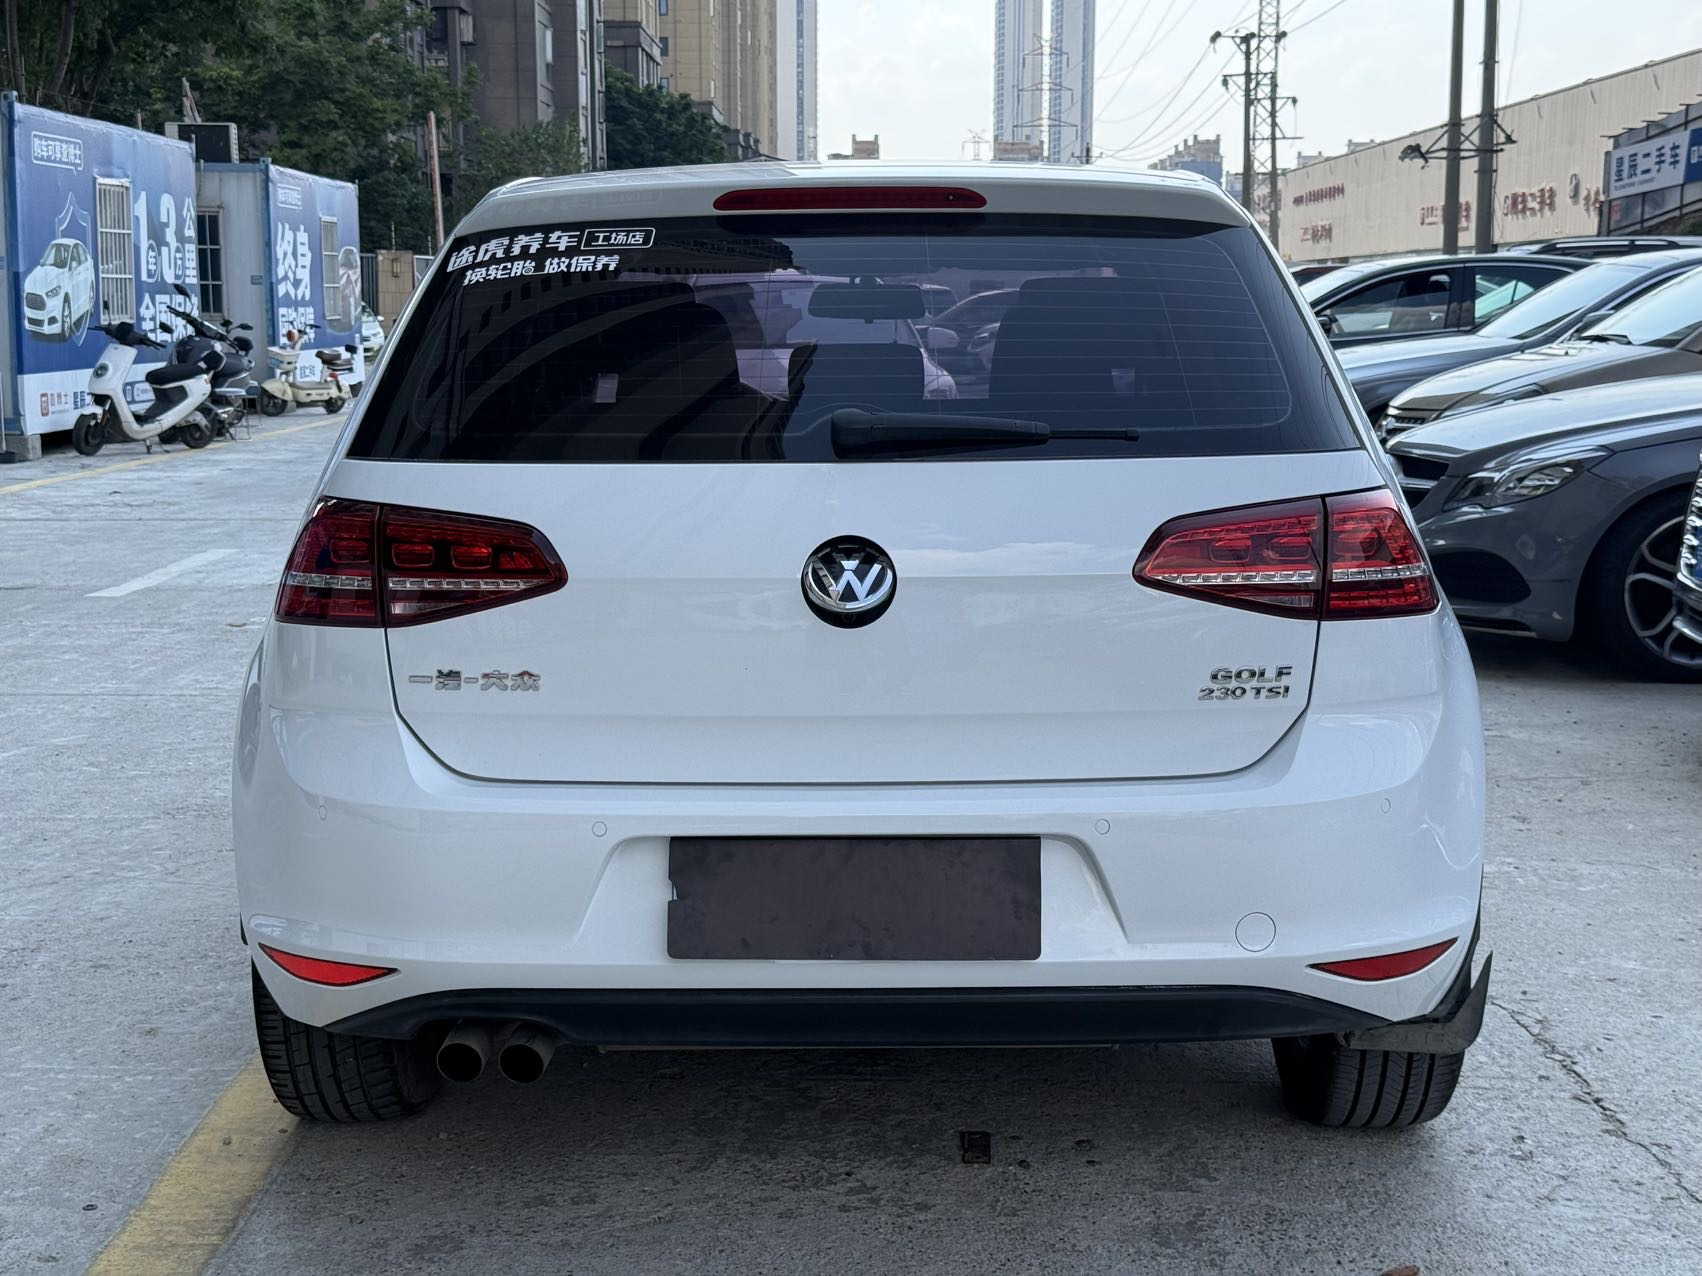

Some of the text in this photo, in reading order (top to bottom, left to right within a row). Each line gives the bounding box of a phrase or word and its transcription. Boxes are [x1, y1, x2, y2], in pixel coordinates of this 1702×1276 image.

[1614, 142, 1681, 182] 星辰二手车
[276, 222, 312, 301] 终身
[446, 230, 645, 272] 途虎养车 工场店
[462, 255, 620, 286] 换轮胎 做保养
[1198, 685, 1290, 700] 230 TSI
[1210, 665, 1292, 685] GOLF
